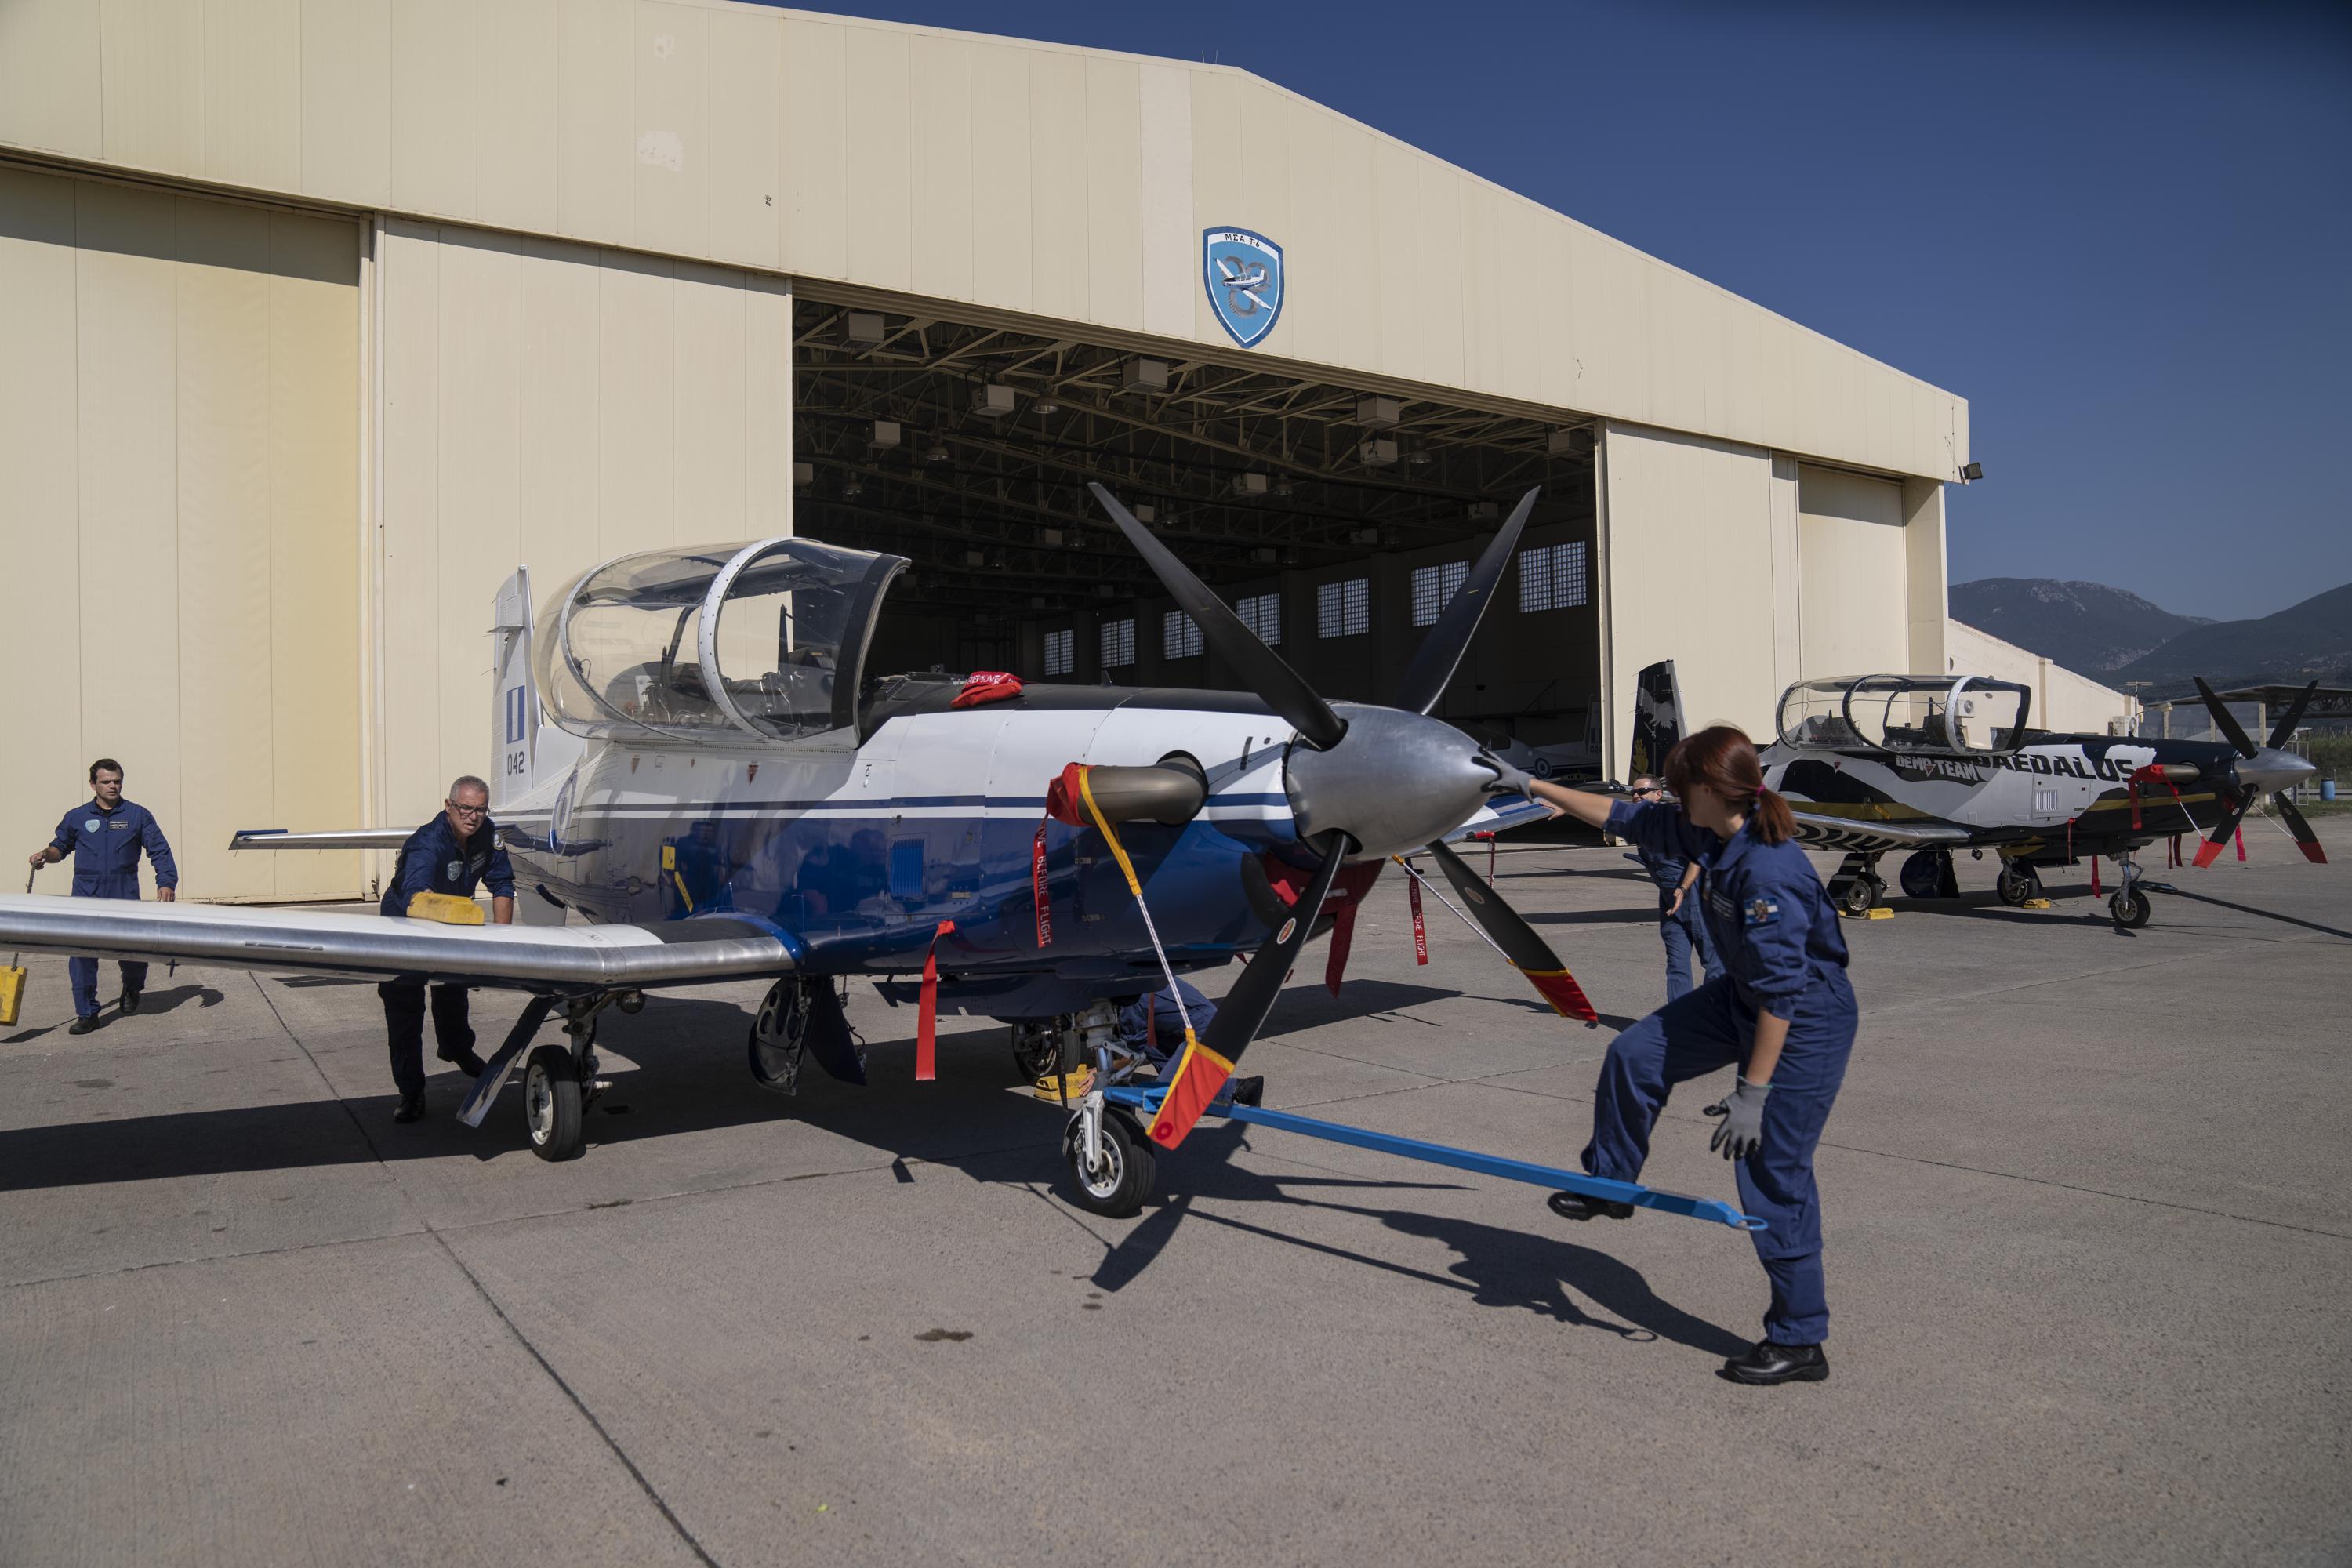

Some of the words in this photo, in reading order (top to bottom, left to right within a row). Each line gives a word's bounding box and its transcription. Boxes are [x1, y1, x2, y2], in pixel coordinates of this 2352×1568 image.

[1250, 238, 1260, 248] T-6
[507, 750, 524, 776] 042
[1933, 759, 1979, 781] TEAM
[1037, 855, 1048, 898] BEFORE
[1040, 906, 1051, 945] FLIGHT
[1413, 908, 1423, 931] BEFORE
[1417, 935, 1425, 956] FLIGHT
